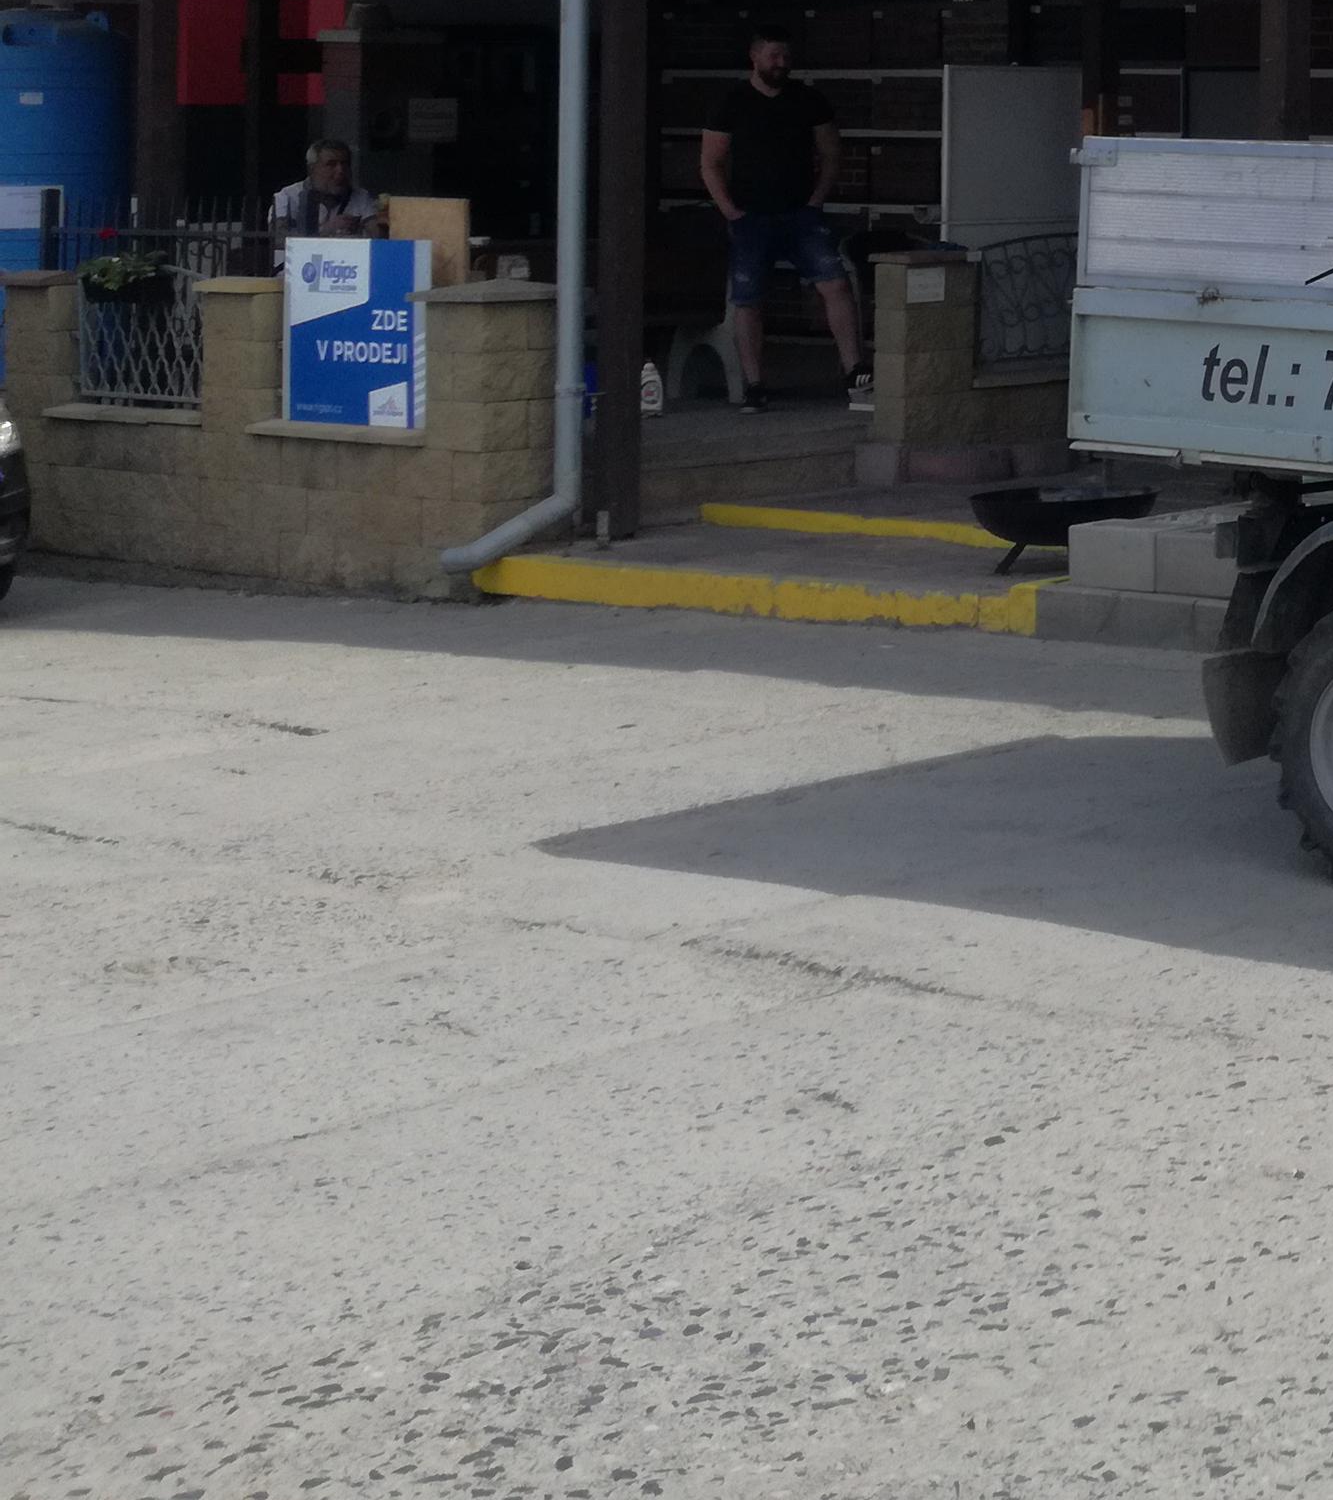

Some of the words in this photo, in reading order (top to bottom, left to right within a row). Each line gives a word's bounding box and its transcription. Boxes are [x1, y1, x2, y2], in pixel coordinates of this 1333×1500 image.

[322, 260, 358, 283] Rigips
[371, 310, 408, 332] ZDE
[316, 339, 329, 361] V
[333, 340, 408, 365] PRODEJI
[1201, 343, 1301, 408] tel.:
